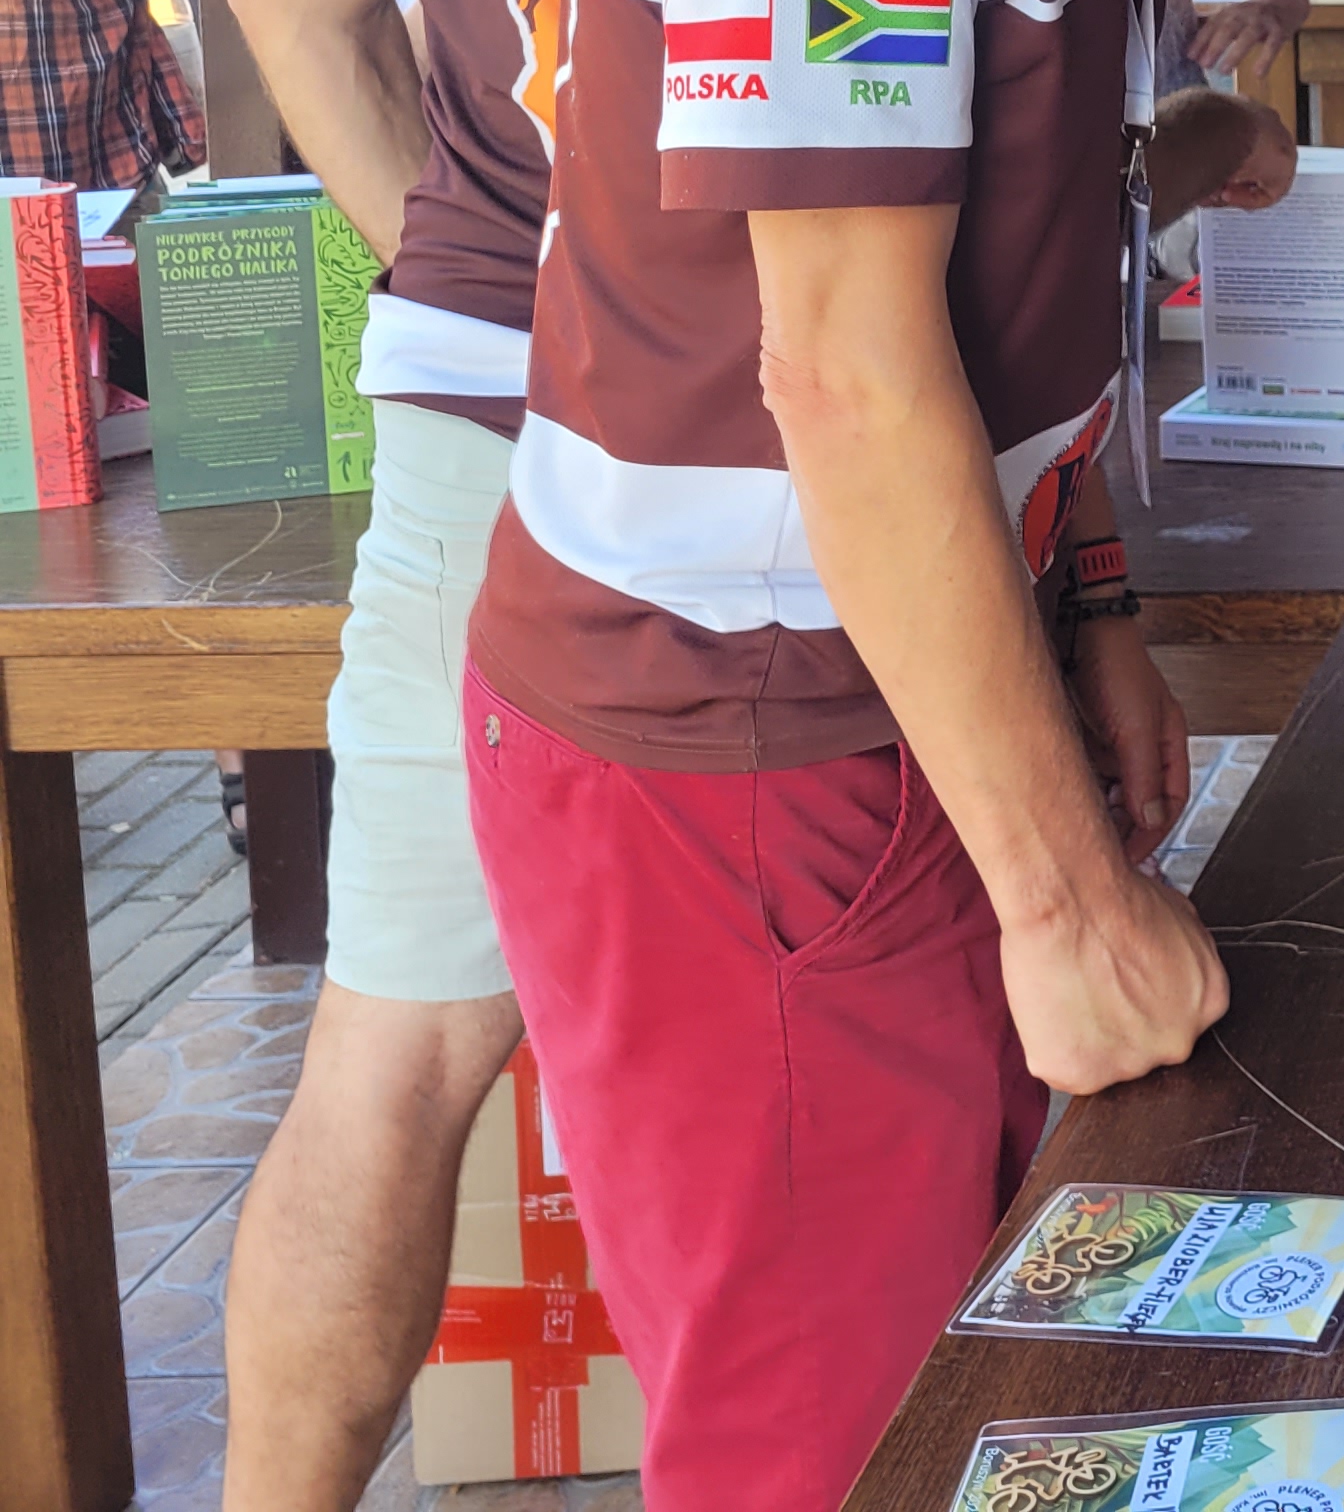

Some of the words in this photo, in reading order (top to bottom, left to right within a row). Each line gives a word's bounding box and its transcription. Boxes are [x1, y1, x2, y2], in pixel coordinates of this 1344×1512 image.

[666, 73, 770, 104] POLSKA
[850, 79, 912, 106] RPA
[156, 240, 298, 266] PODRÓŻNIKA
[158, 262, 234, 282] TONIEGO
[239, 257, 299, 276] HALIKA
